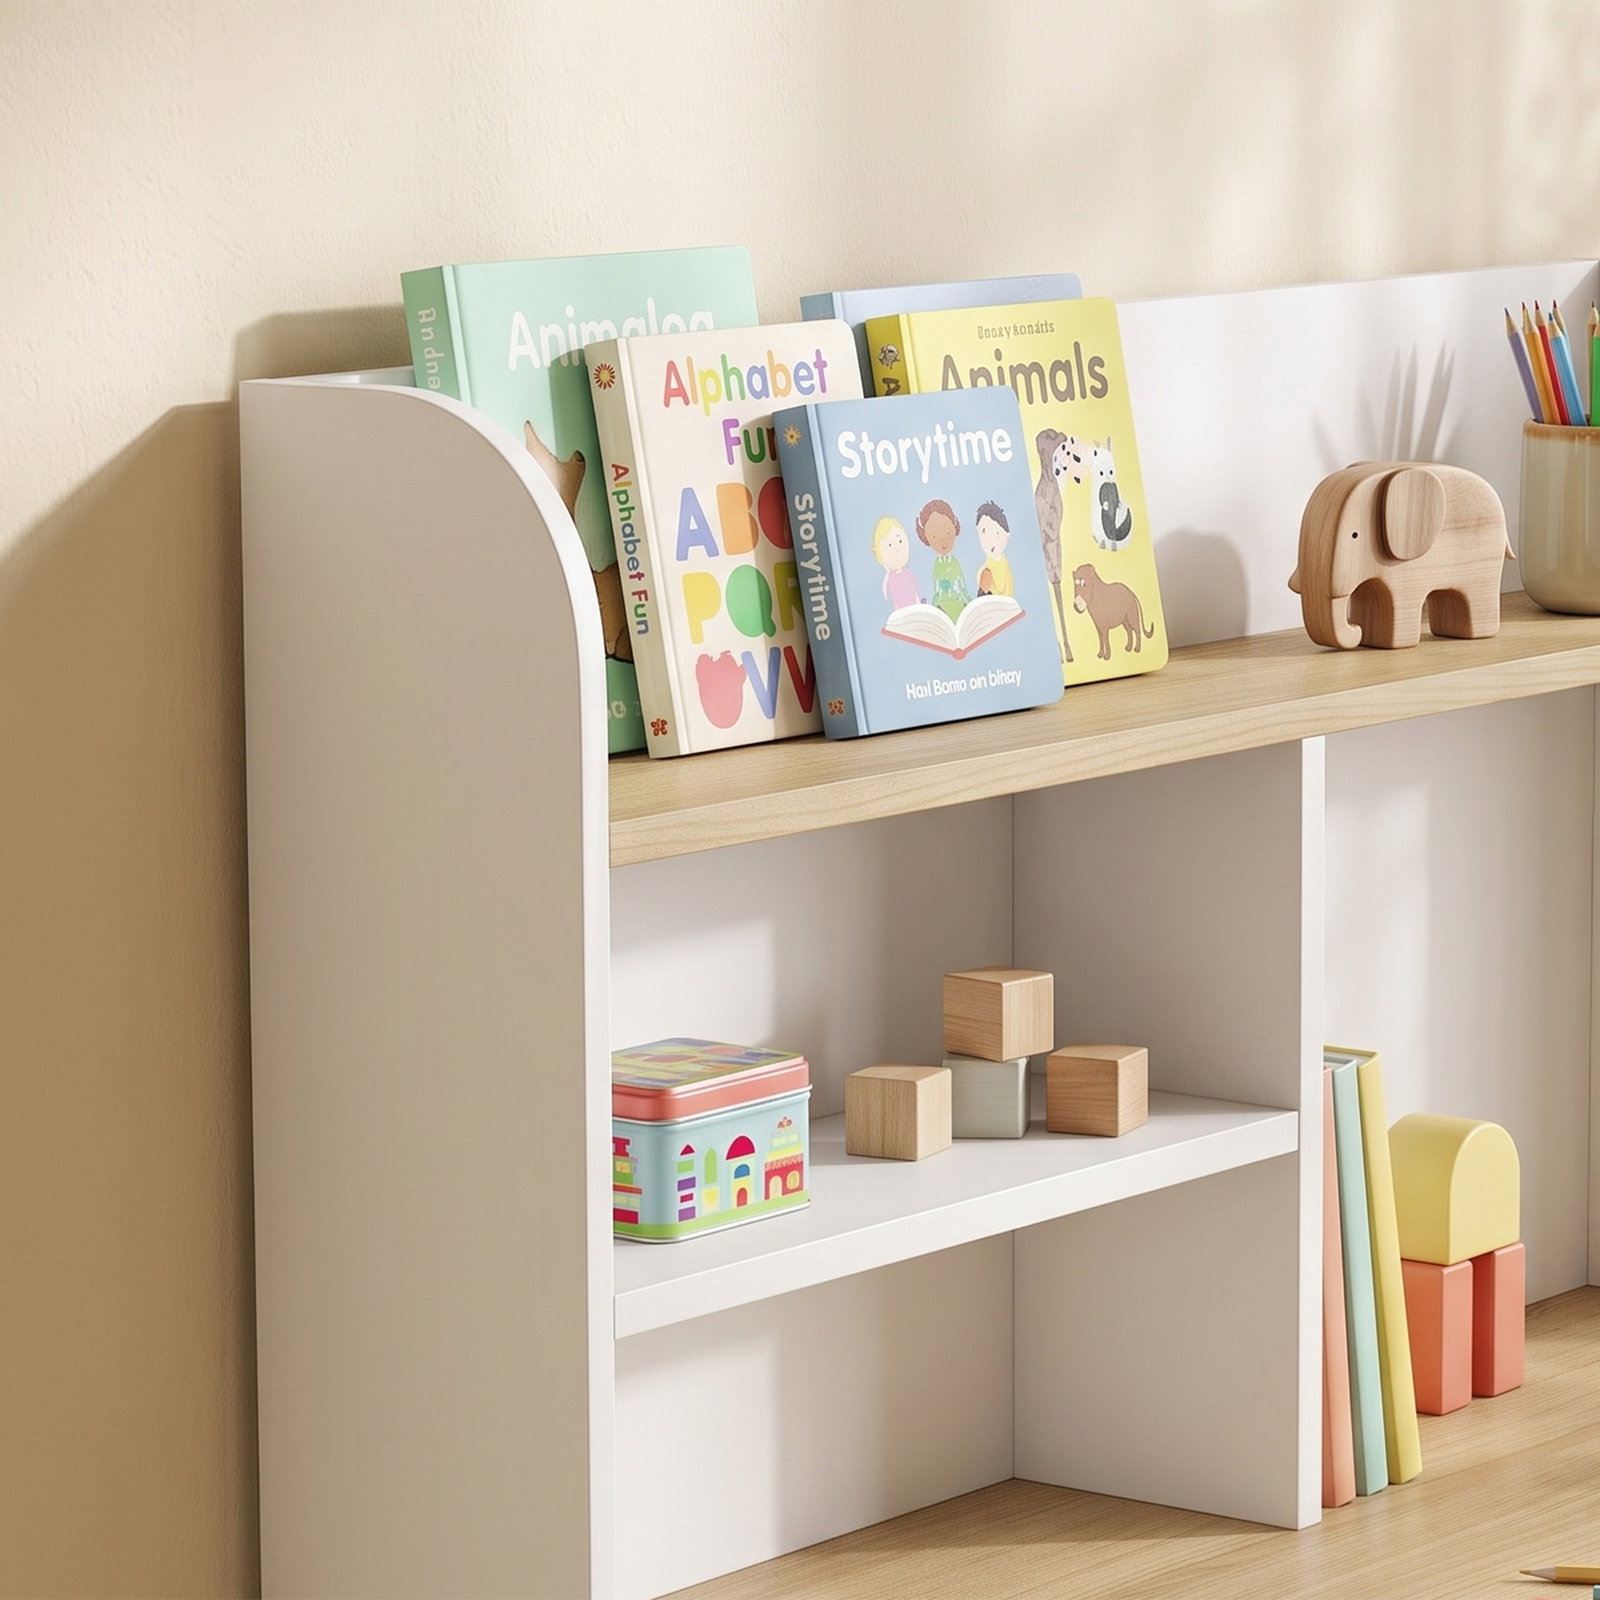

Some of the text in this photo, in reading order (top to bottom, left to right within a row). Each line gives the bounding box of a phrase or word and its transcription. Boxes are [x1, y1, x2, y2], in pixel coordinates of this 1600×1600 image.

[663, 349, 827, 417] Alphabet
[837, 420, 1013, 485] Storytime
[611, 463, 650, 635] Alphabet Fun
[794, 493, 831, 641] Storytime
